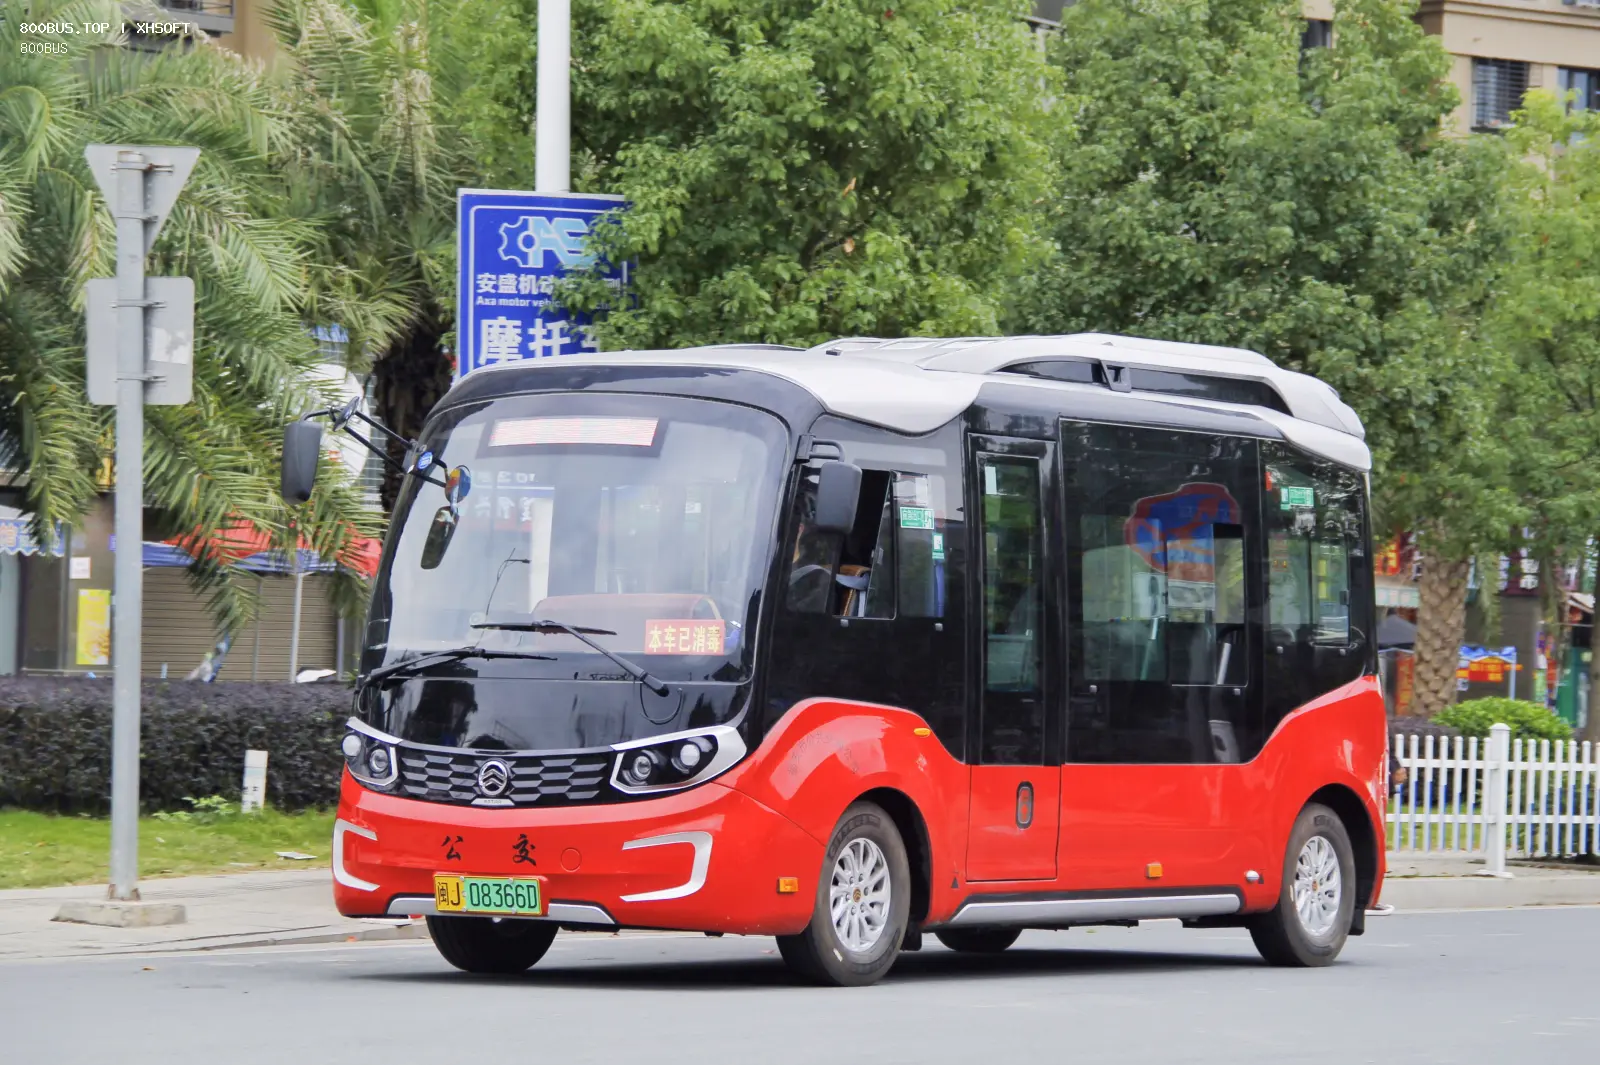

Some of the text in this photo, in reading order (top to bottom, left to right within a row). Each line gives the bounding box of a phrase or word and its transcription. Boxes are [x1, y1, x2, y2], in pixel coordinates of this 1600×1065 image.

[476, 295, 497, 306] Axa
[498, 297, 531, 307] motor
[648, 624, 721, 653] 本车已消毒
